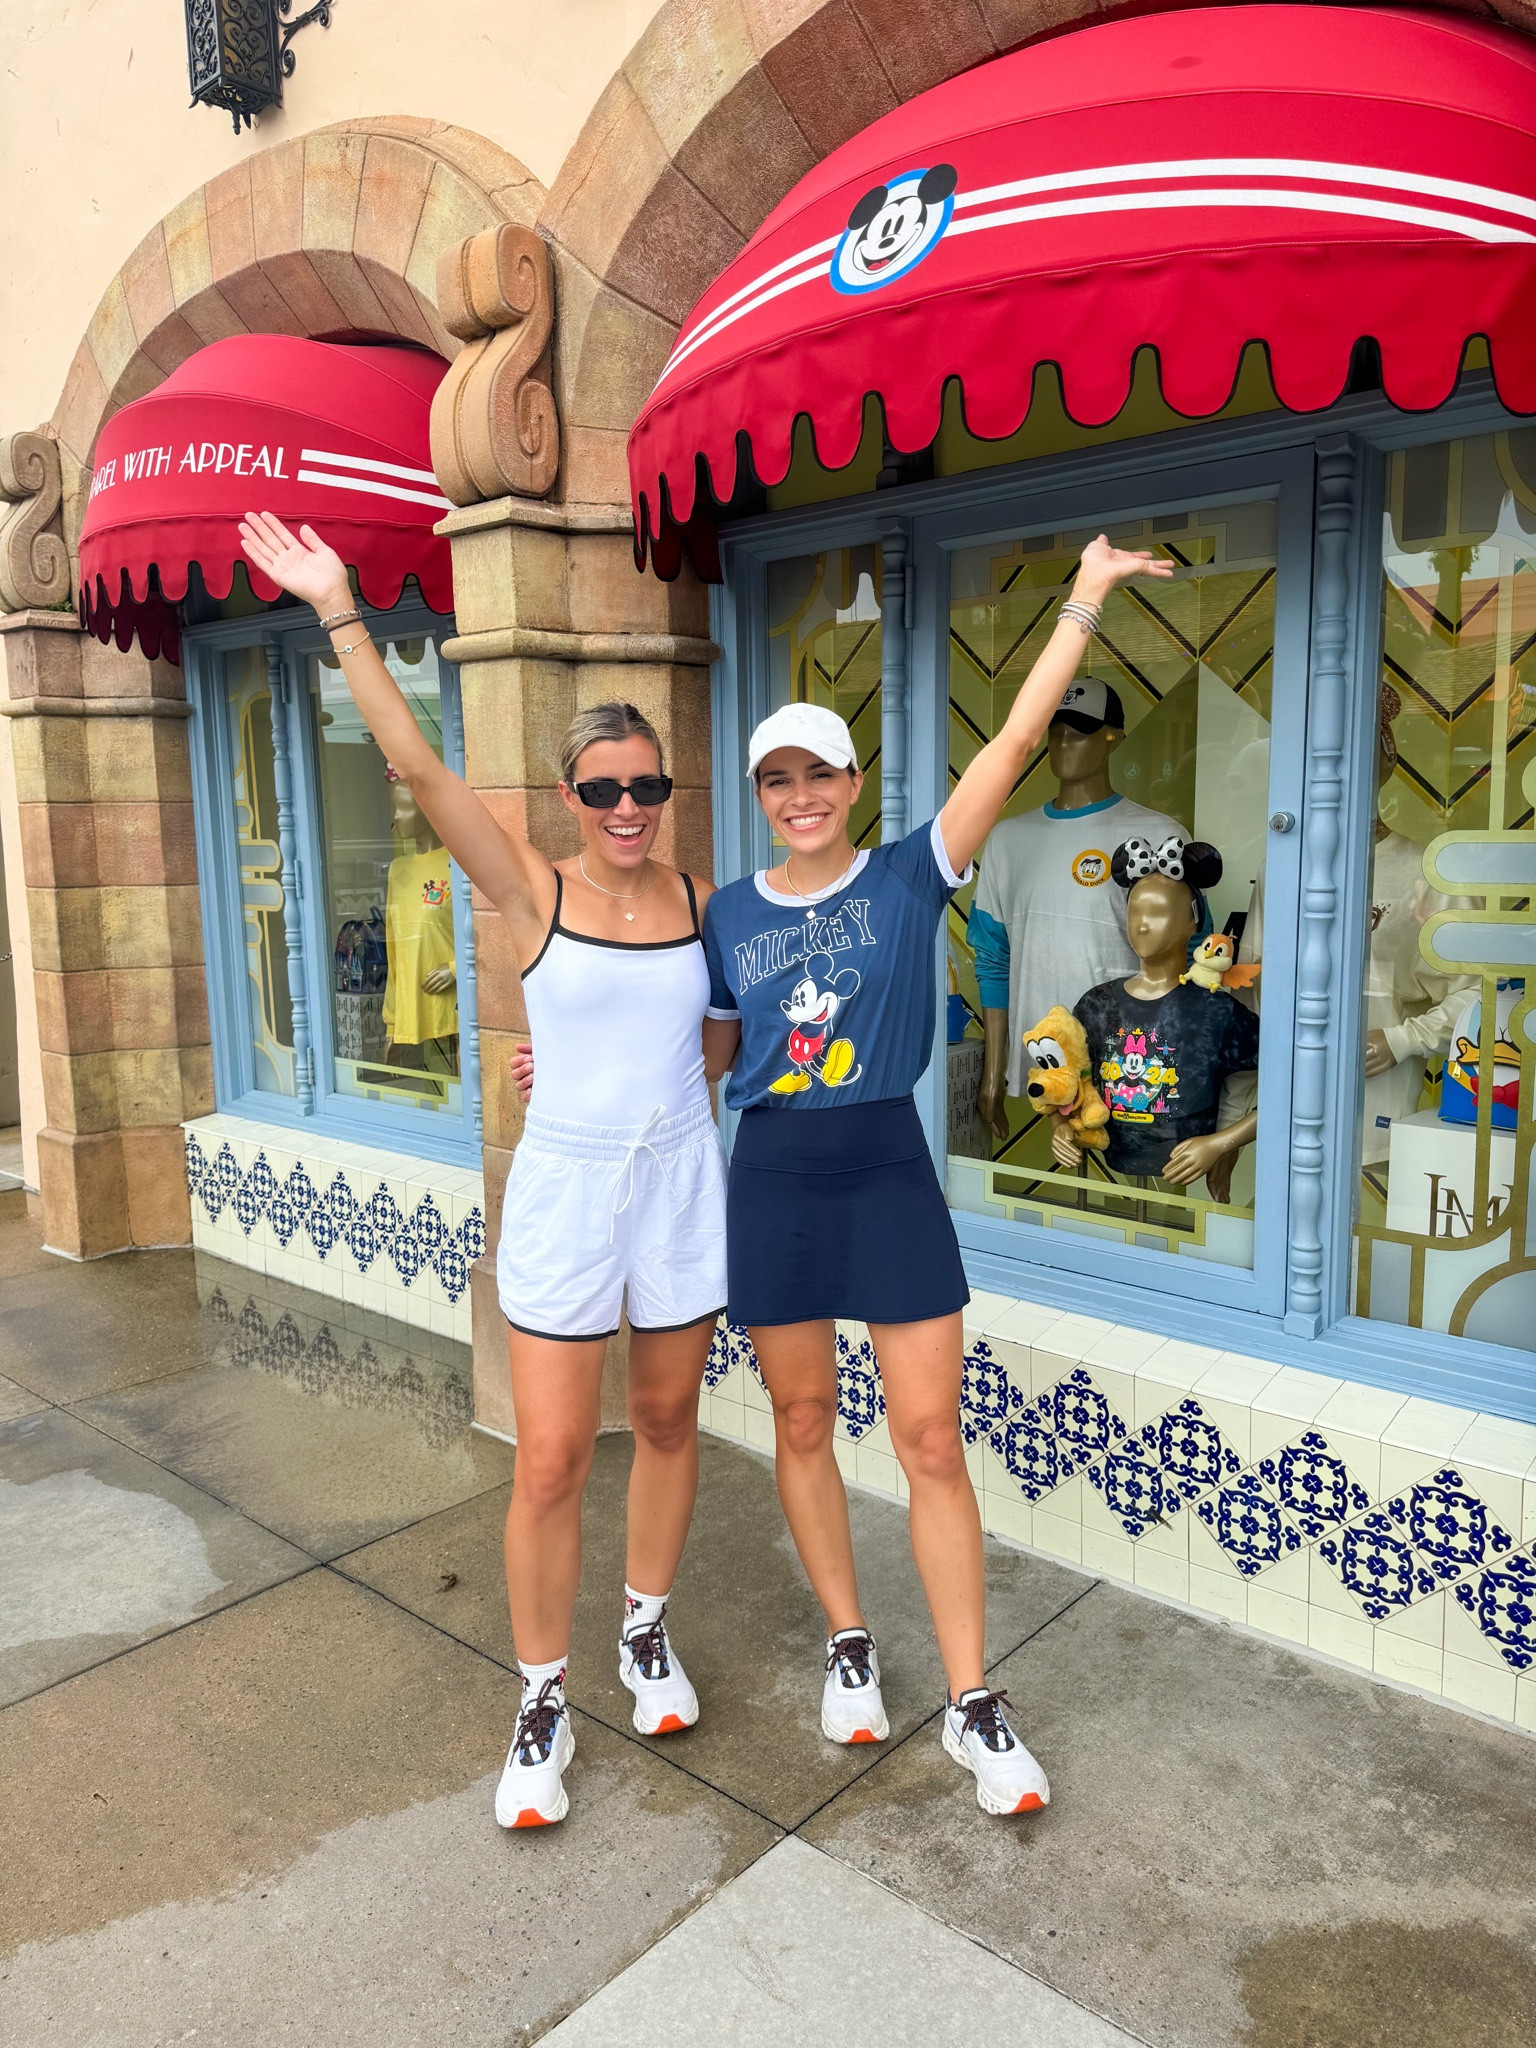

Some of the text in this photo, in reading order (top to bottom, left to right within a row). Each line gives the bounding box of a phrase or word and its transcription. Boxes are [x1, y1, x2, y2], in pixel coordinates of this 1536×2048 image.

[124, 445, 173, 482] WITH
[178, 442, 289, 479] APPEAL
[1090, 877, 1105, 887] DUCK
[734, 899, 877, 996] MICKEY
